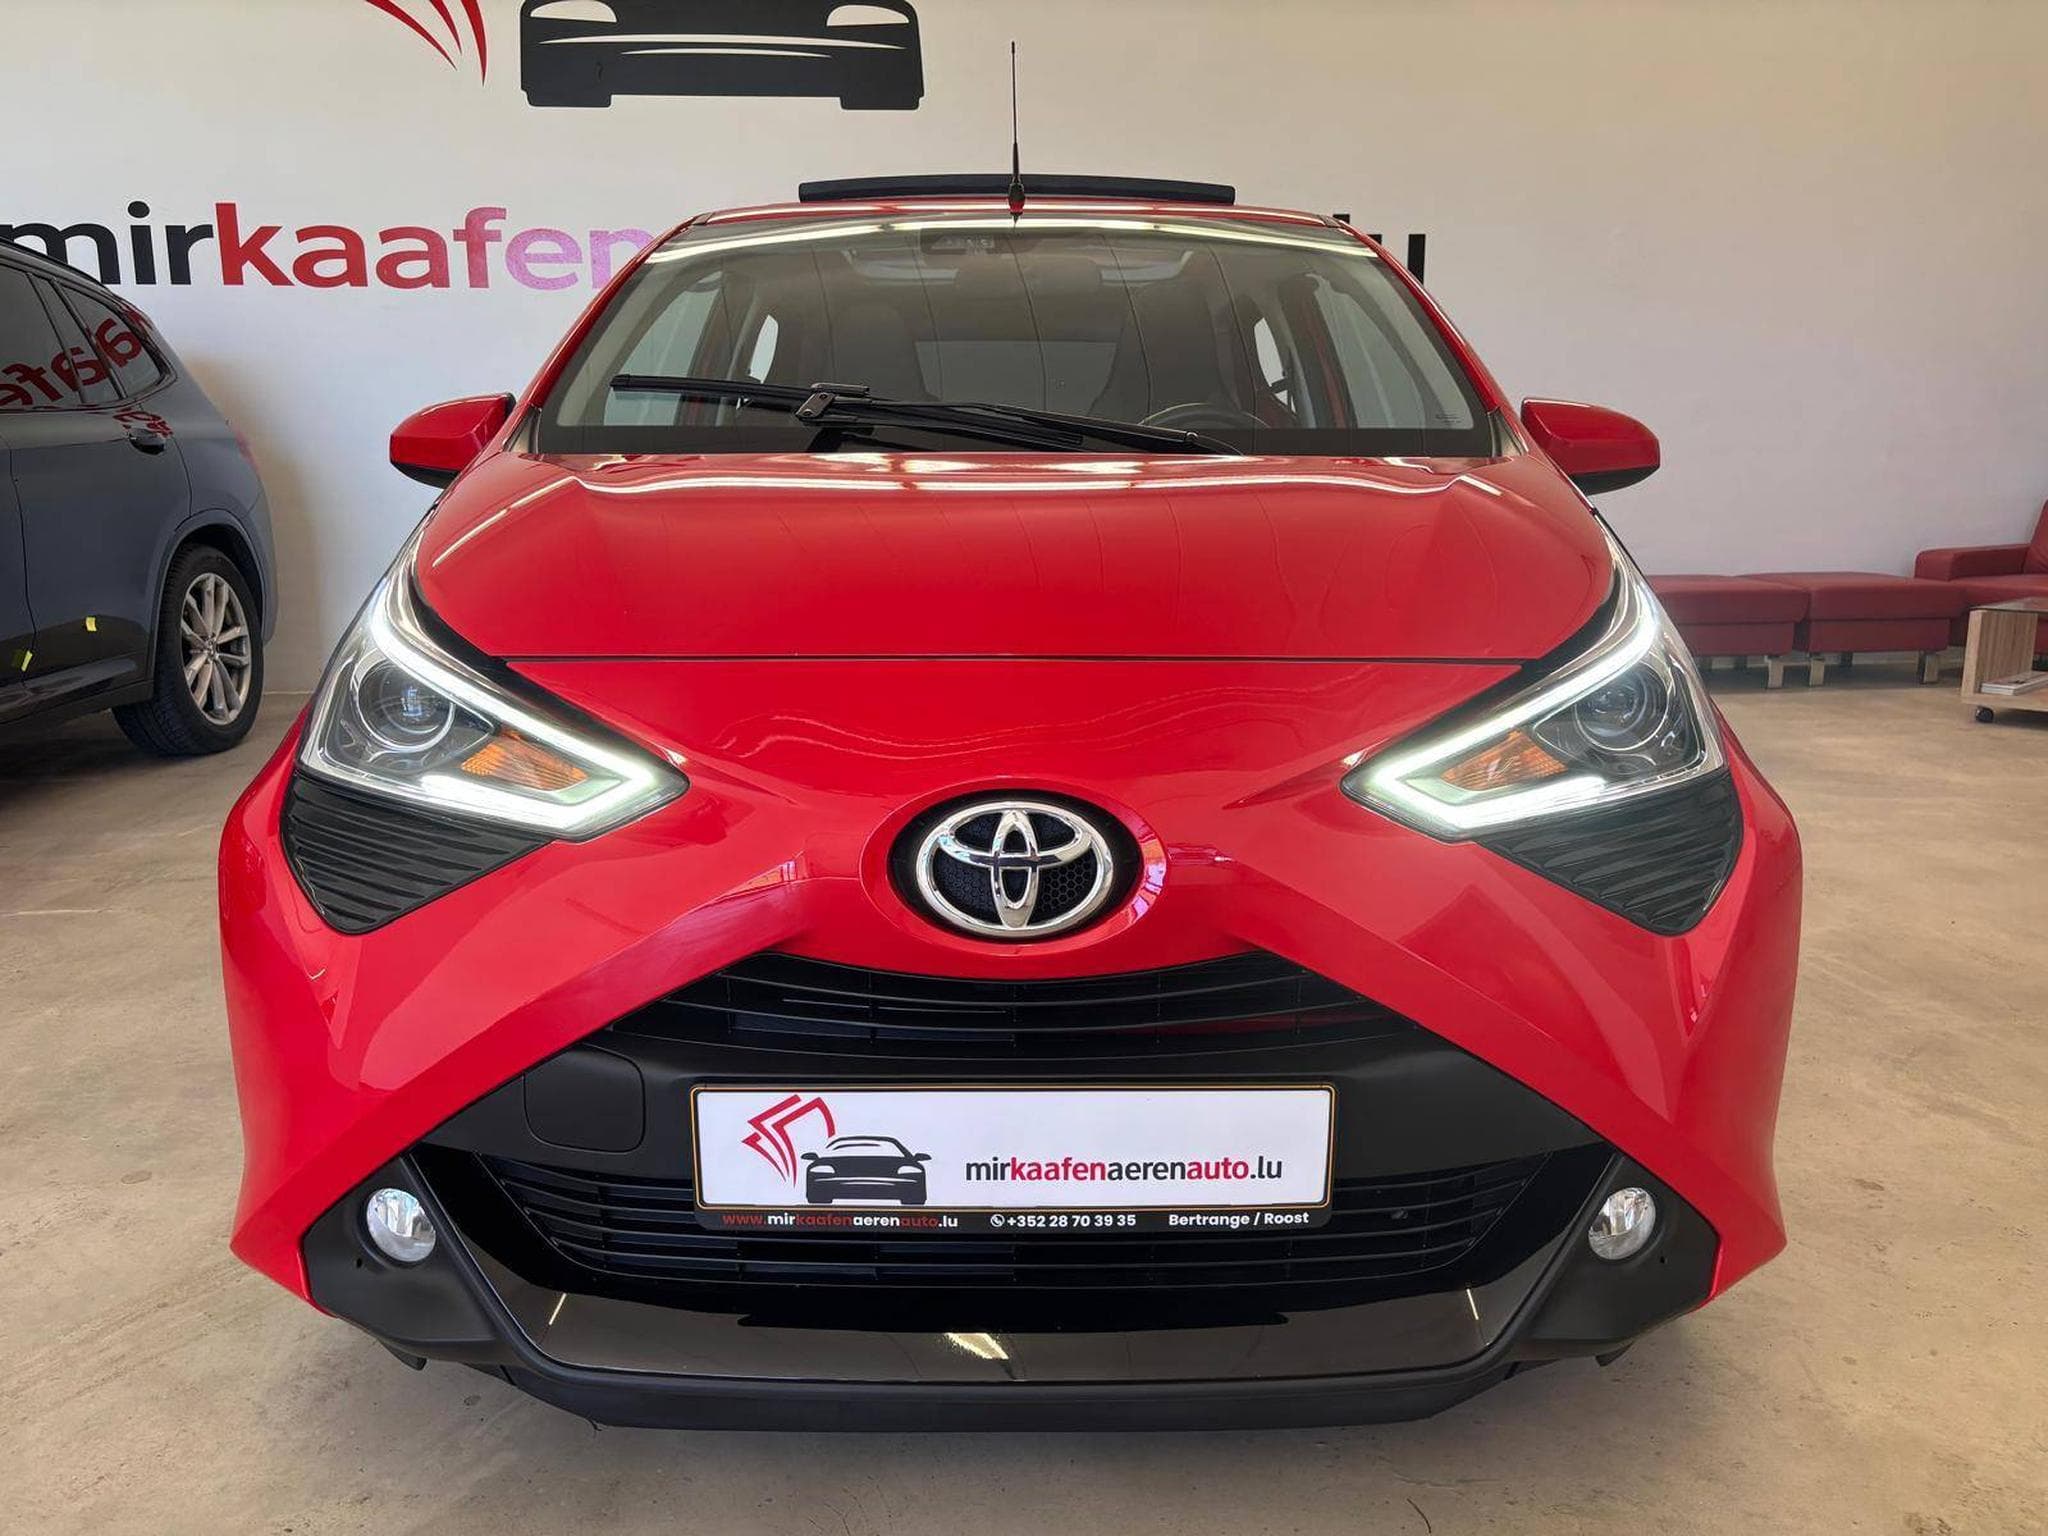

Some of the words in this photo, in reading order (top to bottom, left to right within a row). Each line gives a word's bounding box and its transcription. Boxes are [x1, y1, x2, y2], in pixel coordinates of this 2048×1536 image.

[965, 1155, 1283, 1181] mirkaafenaerenauto.lu
[722, 1213, 958, 1228] www.mirkaafenaerenauto.lu
[1007, 1215, 1046, 1228] +352
[1049, 1215, 1068, 1227] 28
[1072, 1215, 1091, 1227] 70
[1094, 1215, 1114, 1227] 39
[1117, 1214, 1137, 1226] 35
[1169, 1213, 1250, 1229] Bertrange
[1253, 1212, 1261, 1226] /
[1264, 1212, 1309, 1225] Roost
